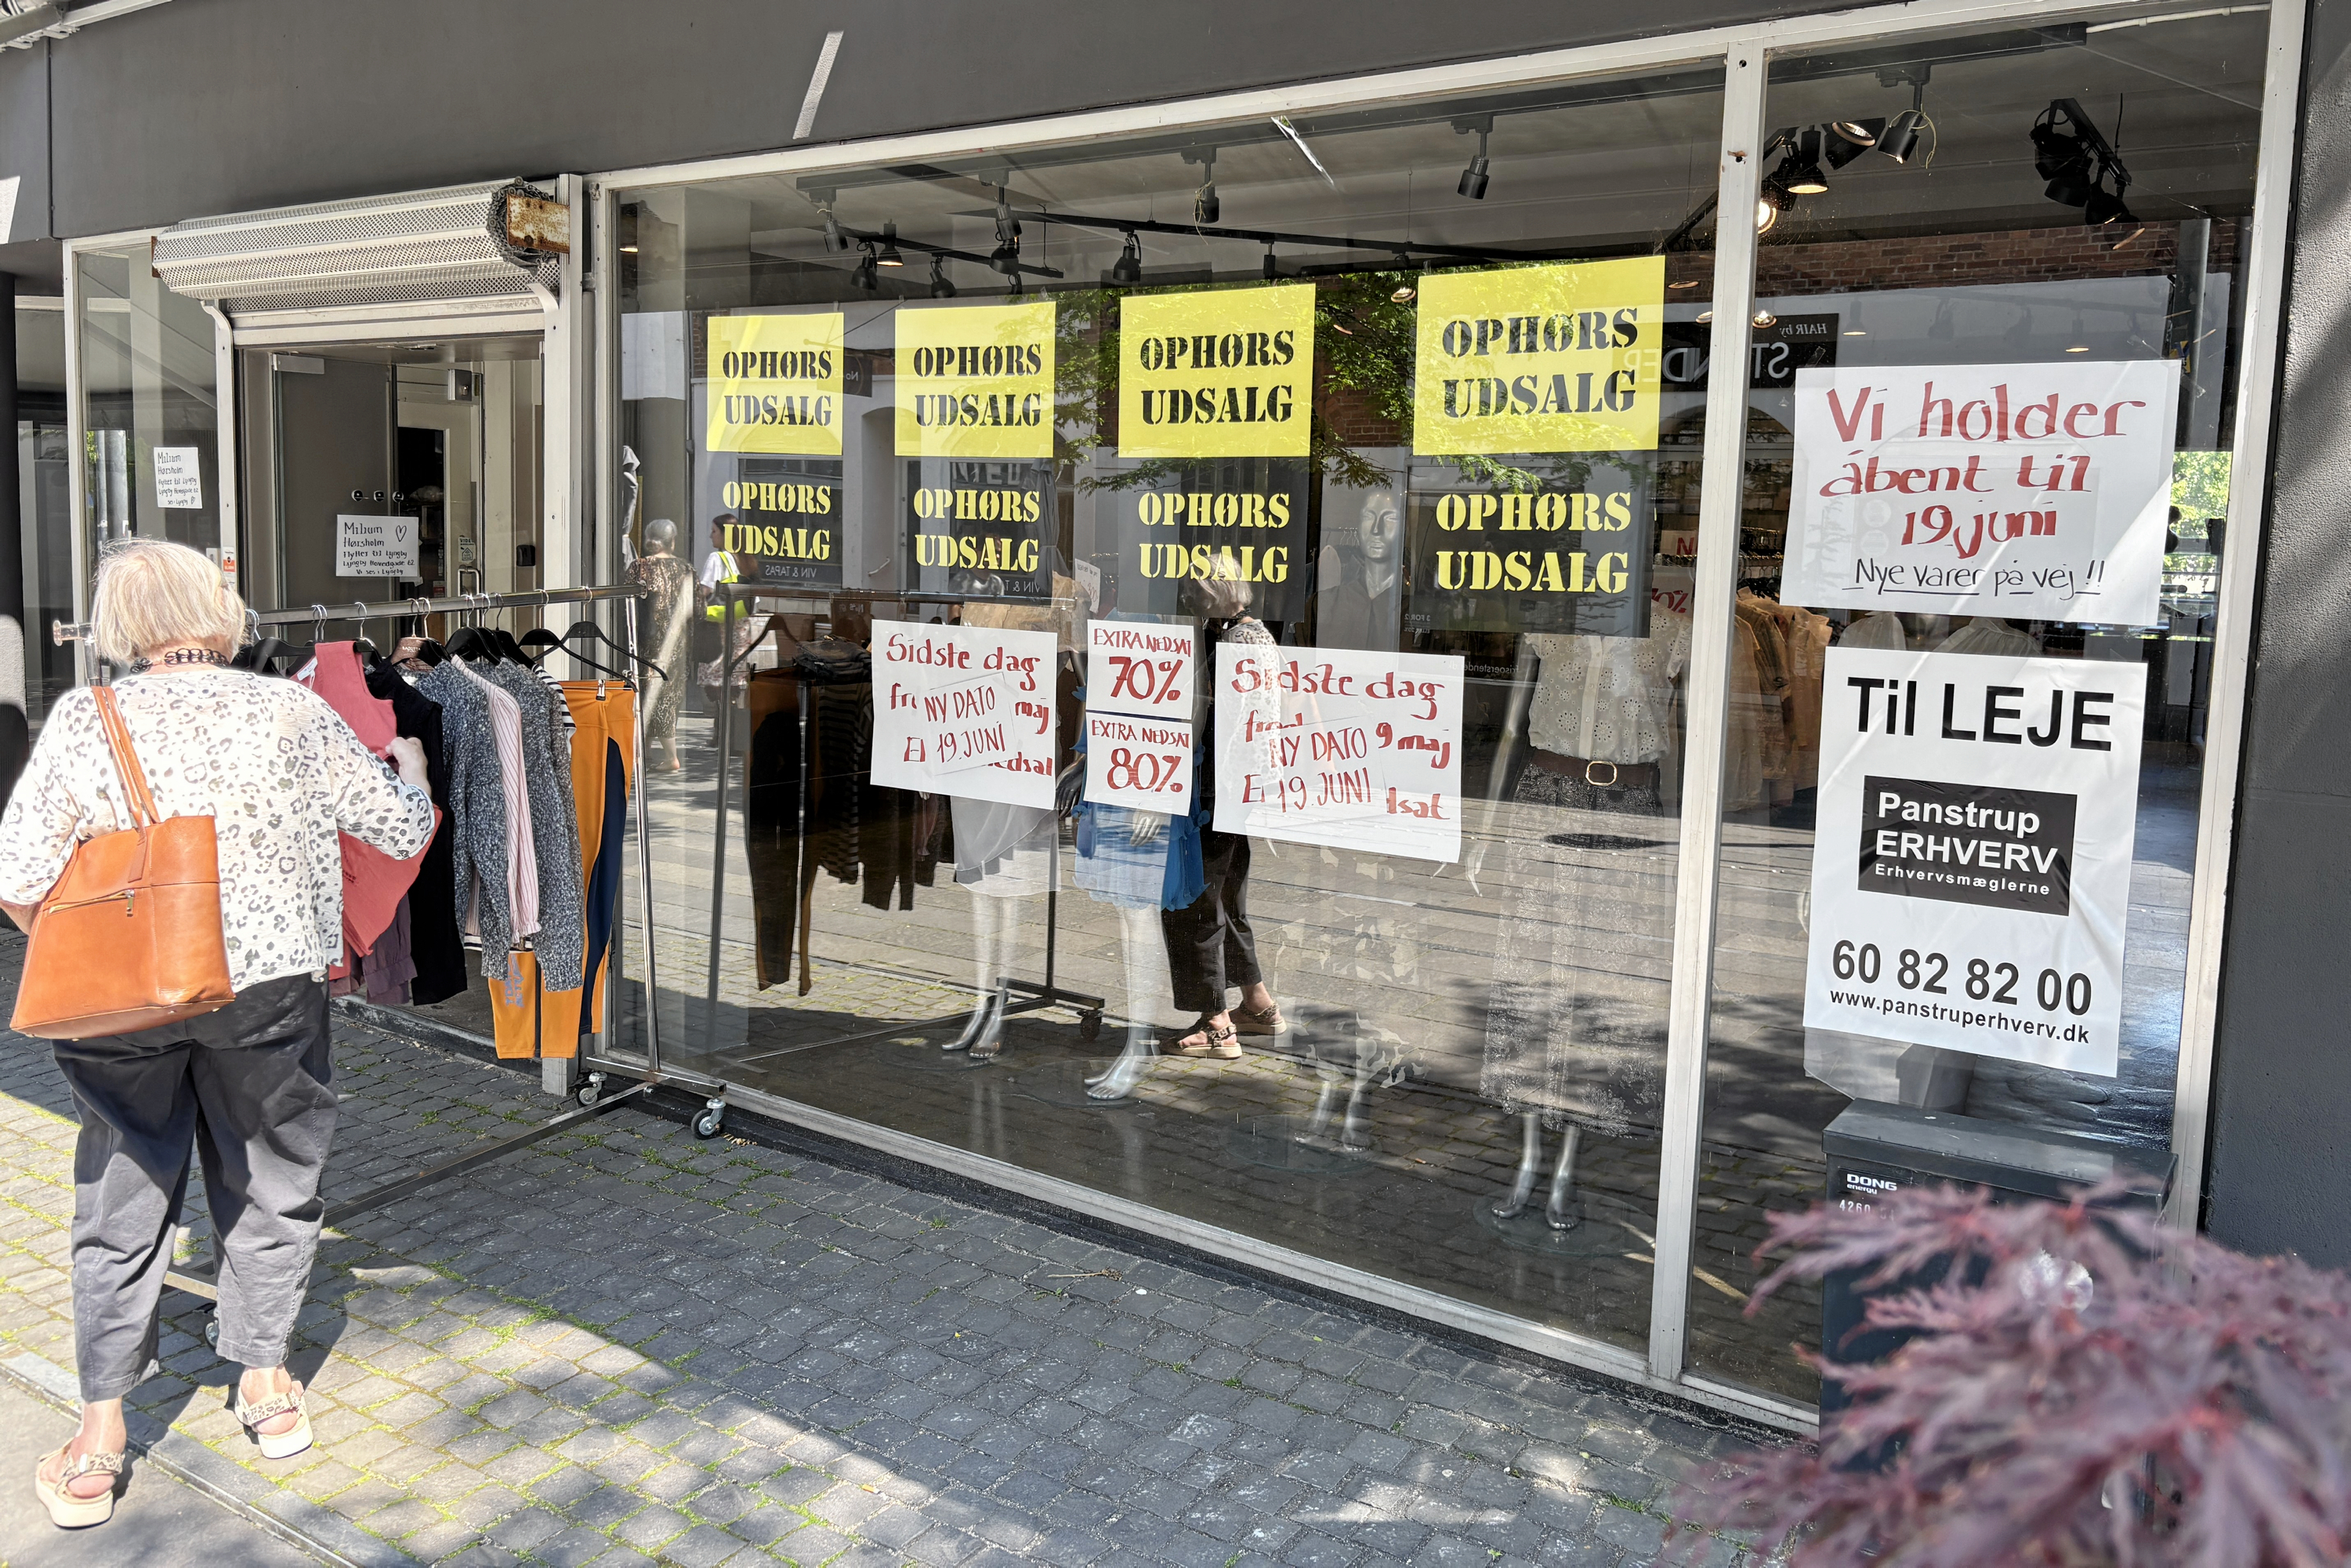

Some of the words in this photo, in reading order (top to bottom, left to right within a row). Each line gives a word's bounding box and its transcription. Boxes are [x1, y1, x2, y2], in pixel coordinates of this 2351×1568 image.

[1140, 330, 1295, 371] OPHØRS
[1442, 307, 1639, 358] OPHØRS
[723, 349, 832, 380] OPHØRS
[913, 343, 1042, 378] OPHØRS
[725, 394, 832, 427] UDSALG
[915, 393, 1041, 427] UDSALG
[1141, 384, 1293, 425] UDSALG
[1443, 369, 1637, 418] UDSALG
[1826, 386, 1889, 443] Vi
[1918, 381, 2146, 442] holder
[2017, 454, 2092, 493] til
[723, 480, 831, 516] OPHØRS
[913, 487, 1041, 523] OPHØRS
[1138, 491, 1291, 529] OPHØRS
[1436, 492, 1632, 533] OPHØRS
[343, 537, 385, 548] Hørsholm
[344, 522, 382, 534] Milium
[723, 523, 831, 561] UDSALG
[1952, 499, 2058, 559] juni
[343, 560, 367, 569] Lyngby
[386, 550, 408, 559] Lyngby
[915, 534, 1040, 573] UDSALG
[1139, 542, 1289, 585] UDSALG
[1436, 550, 1630, 594] UDSALG
[1855, 557, 1904, 596] Nye
[1913, 564, 1986, 587] varer
[2032, 563, 2075, 601] vej
[886, 633, 973, 669] Sidste
[983, 646, 1041, 691] dag
[1093, 628, 1144, 650] EXTRA
[1146, 634, 1192, 657] NEDSAT
[1108, 656, 1183, 704] 70%
[1231, 658, 1359, 697] Sidste
[1365, 672, 1446, 721] dag
[923, 693, 947, 723] NY
[953, 685, 995, 719] DATO
[1015, 697, 1049, 735] maj
[1847, 676, 1918, 737] Til
[1941, 683, 2115, 752] LEJE
[960, 720, 1006, 758] JUNI
[1091, 719, 1137, 741] EXTRA
[1142, 727, 1190, 749] NEDSAT
[1269, 734, 1301, 769] NY
[1310, 726, 1367, 762] DATO
[1397, 729, 1451, 770] maj
[1107, 748, 1184, 793] 80%
[1317, 767, 1371, 806] JUNI
[1878, 791, 2040, 838] Panstrup
[1875, 830, 2059, 875] ERHVERV
[1875, 864, 2050, 896] Erhvervsmæglerne
[1832, 940, 1882, 984] 60
[1896, 948, 1949, 995] 82
[1965, 958, 2020, 1005] 82
[2037, 968, 2092, 1016] 00
[1830, 990, 2090, 1045] www.panstruperhverv.dk
[1846, 1173, 1897, 1191] DONG
[1846, 1183, 1878, 1195] energy
